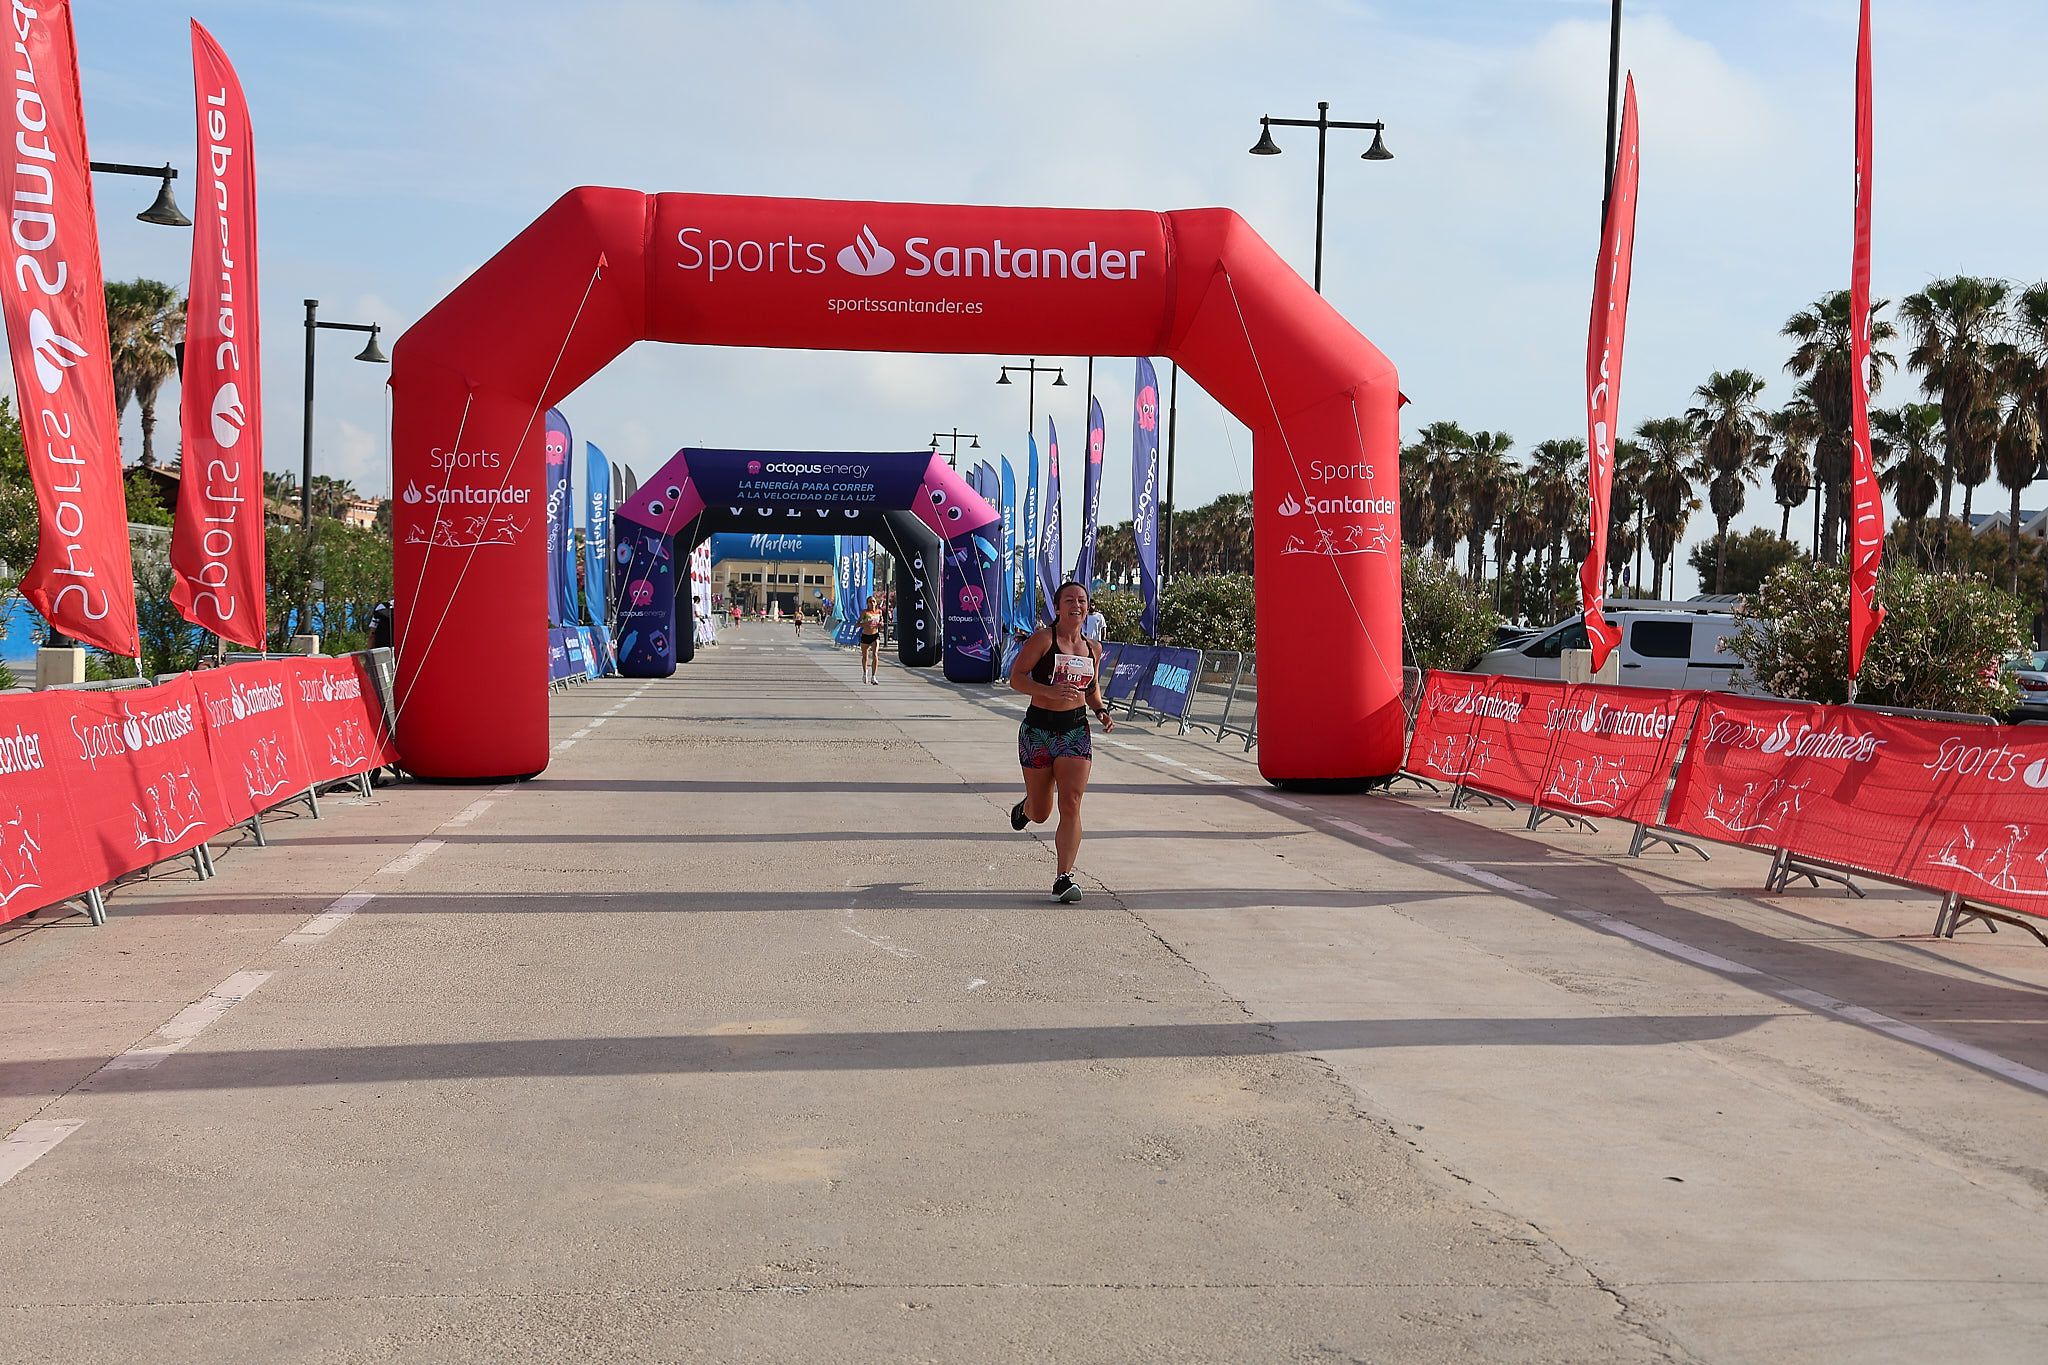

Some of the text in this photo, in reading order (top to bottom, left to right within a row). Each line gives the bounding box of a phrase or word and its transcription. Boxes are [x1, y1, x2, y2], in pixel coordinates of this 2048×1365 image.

[676, 227, 1146, 282] Sports Santander
[827, 297, 983, 316] sportssantander.es
[430, 447, 500, 473] Sports
[766, 462, 870, 479] octopus energy
[1310, 460, 1375, 485] Sports
[425, 484, 531, 504] Santander
[737, 491, 745, 499] A
[747, 491, 761, 499] LA
[763, 492, 823, 501] VELOCIDAD
[738, 480, 875, 492] LA ENERGÍA PARA CORRER
[1304, 495, 1396, 515] Santander
[948, 615, 973, 623] octopus
[1543, 700, 1676, 739] Sports Santander
[1703, 710, 1766, 750] Sports
[0, 724, 45, 775] ander
[70, 714, 126, 771] Sports
[1923, 736, 2025, 781] Sports
